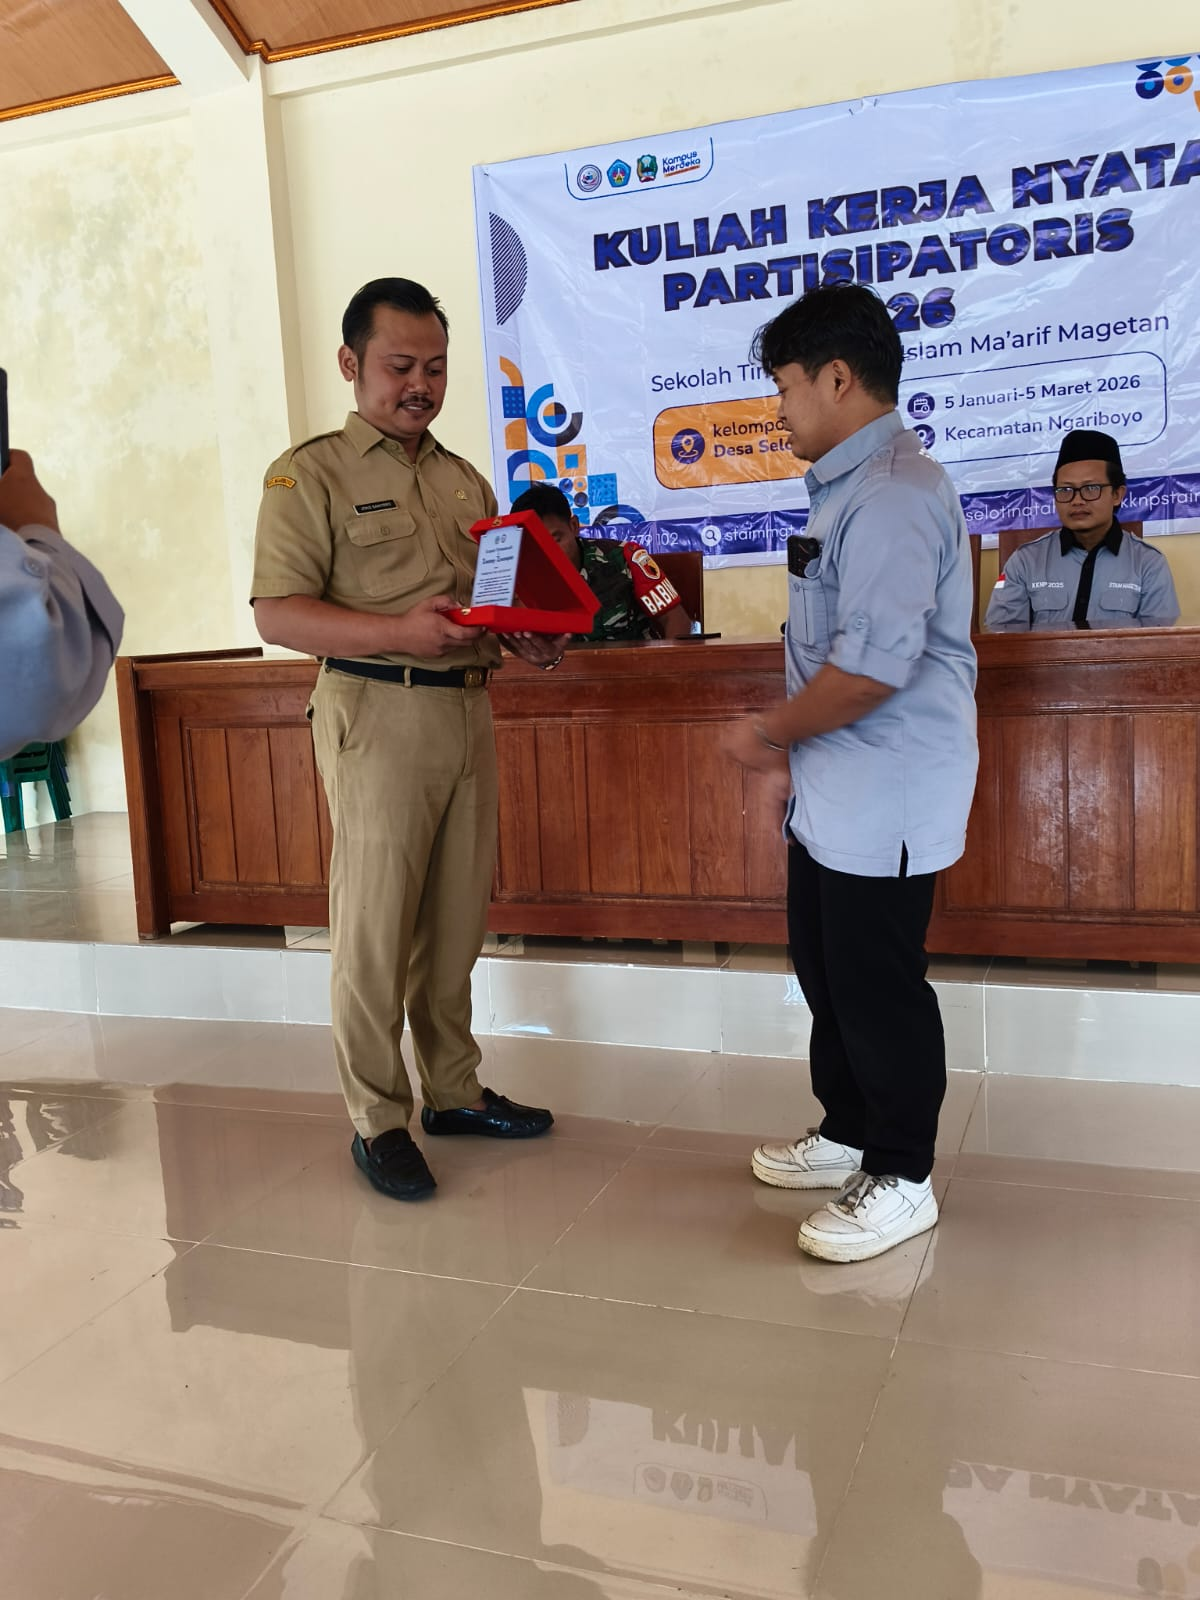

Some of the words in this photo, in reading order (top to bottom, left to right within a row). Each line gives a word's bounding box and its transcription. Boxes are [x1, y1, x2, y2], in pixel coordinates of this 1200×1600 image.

[662, 151, 698, 166] Kampus
[662, 158, 701, 174] Merdeka
[593, 204, 788, 272] KULIAH
[807, 174, 995, 240] KERJA
[1011, 139, 1200, 209] NYATA
[663, 207, 1135, 312] PARTISIPATORIS
[651, 366, 732, 392] Sekolah
[970, 326, 1052, 353] Ma'arif
[1058, 315, 1169, 343] Magetan
[944, 396, 955, 409] 5
[958, 387, 1036, 408] Januari-5
[1041, 380, 1092, 398] Maret
[1097, 375, 1141, 392] 2026
[945, 419, 1042, 441] Kecamatan
[1048, 410, 1143, 431] Ngariboyo
[714, 444, 753, 458] Desa
